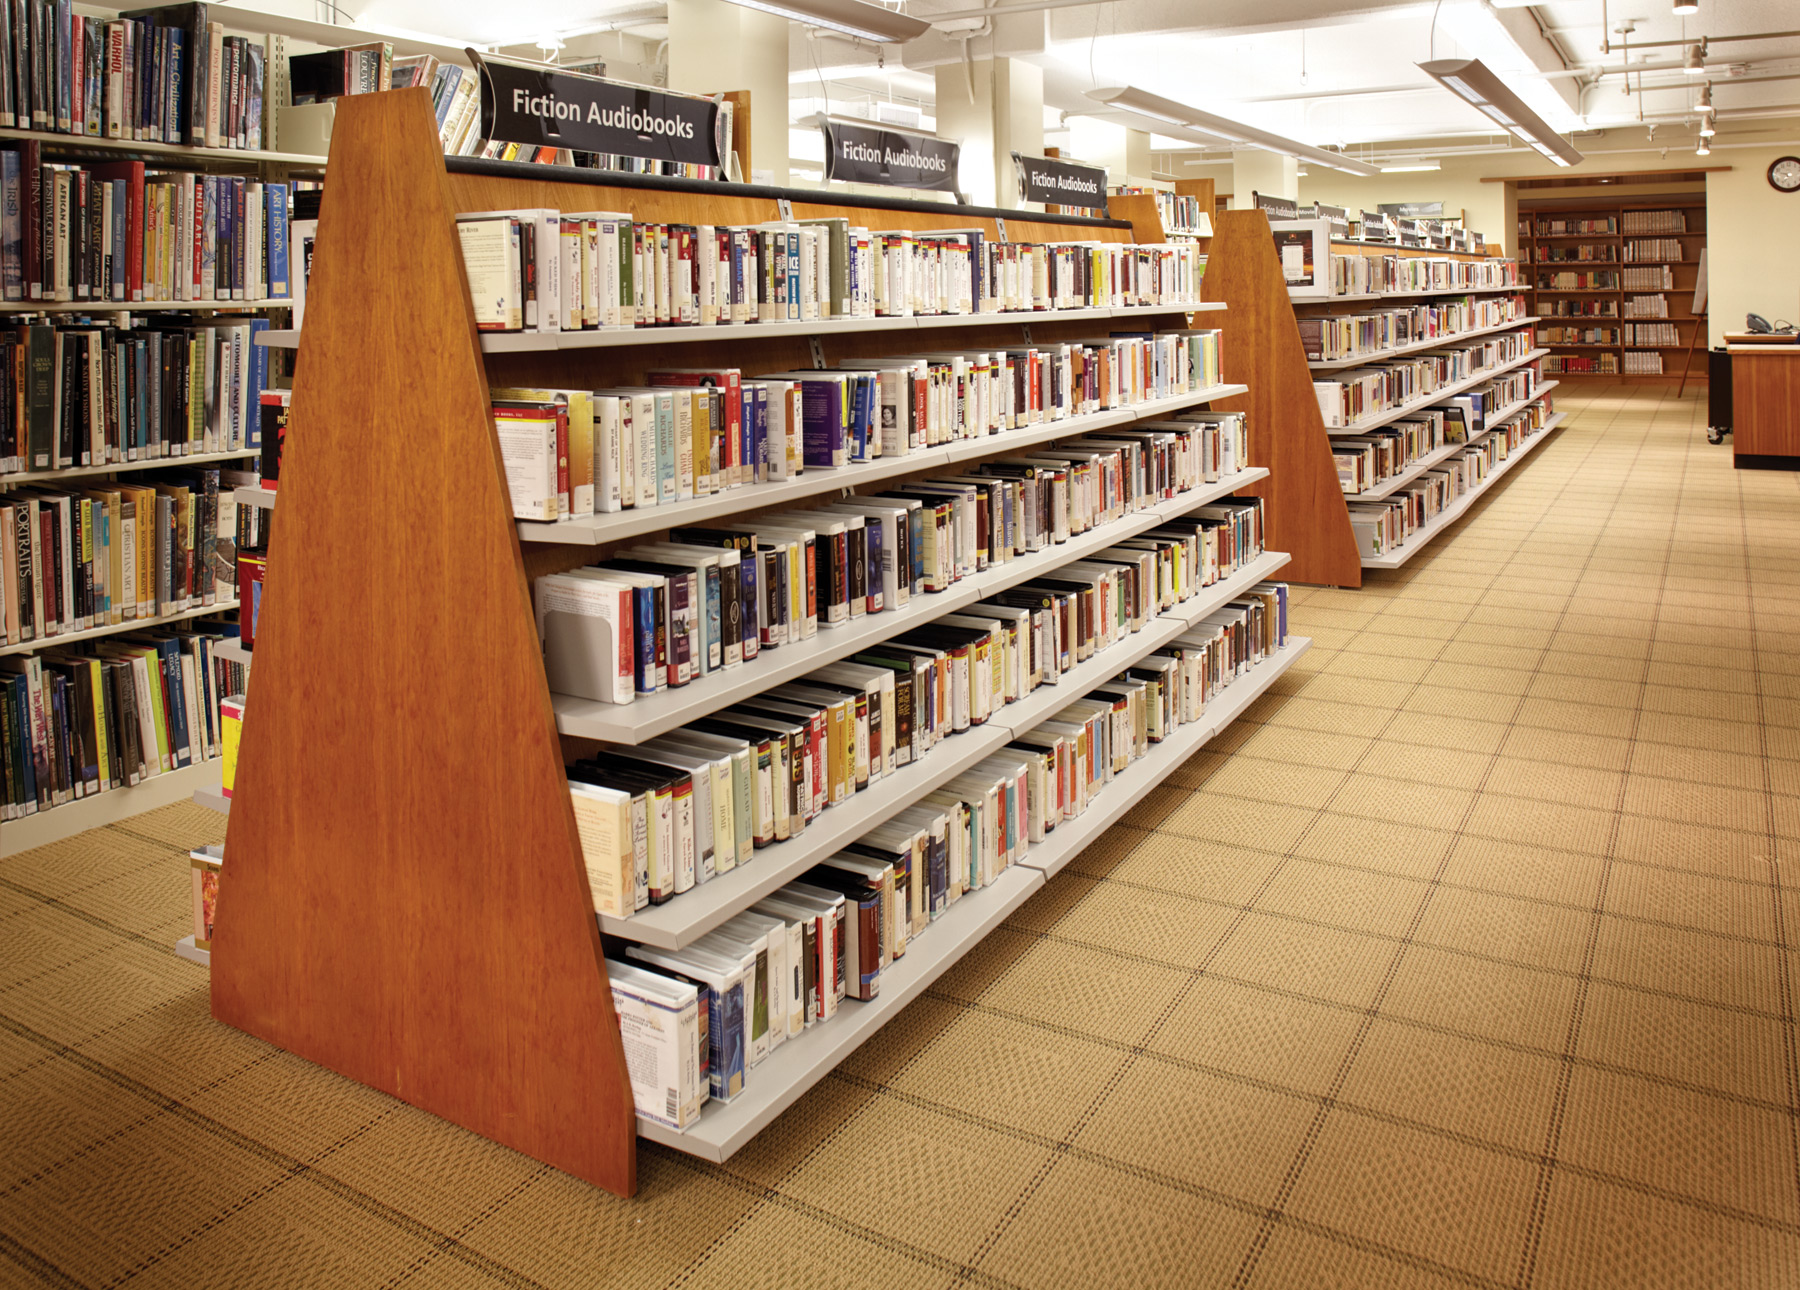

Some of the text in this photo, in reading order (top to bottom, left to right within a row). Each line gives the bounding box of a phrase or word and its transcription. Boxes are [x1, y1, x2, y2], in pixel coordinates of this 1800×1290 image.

[112, 30, 122, 74] WARHOL
[172, 43, 181, 59] Art
[211, 48, 219, 124] POST-MODERNISM
[232, 48, 240, 105] performance
[170, 72, 180, 131] Civilization
[513, 89, 694, 138] Fiction Audiobooks
[843, 141, 946, 172] Fiction Audiobooks
[32, 168, 40, 204] CHINA
[1032, 171, 1097, 194] Fiction Audiobooks
[93, 186, 101, 211] WHAT
[273, 189, 281, 209] ART
[46, 222, 53, 232] OF
[93, 215, 101, 225] IS
[273, 212, 282, 252] HISTORY
[93, 225, 101, 251] ART?
[789, 256, 799, 269] ICE
[232, 406, 240, 442] CULTURE
[17, 506, 31, 577] PORTRAITS
[165, 556, 170, 565] OF
[34, 689, 42, 703] The
[34, 705, 42, 723] Way
[794, 751, 803, 778] 945
